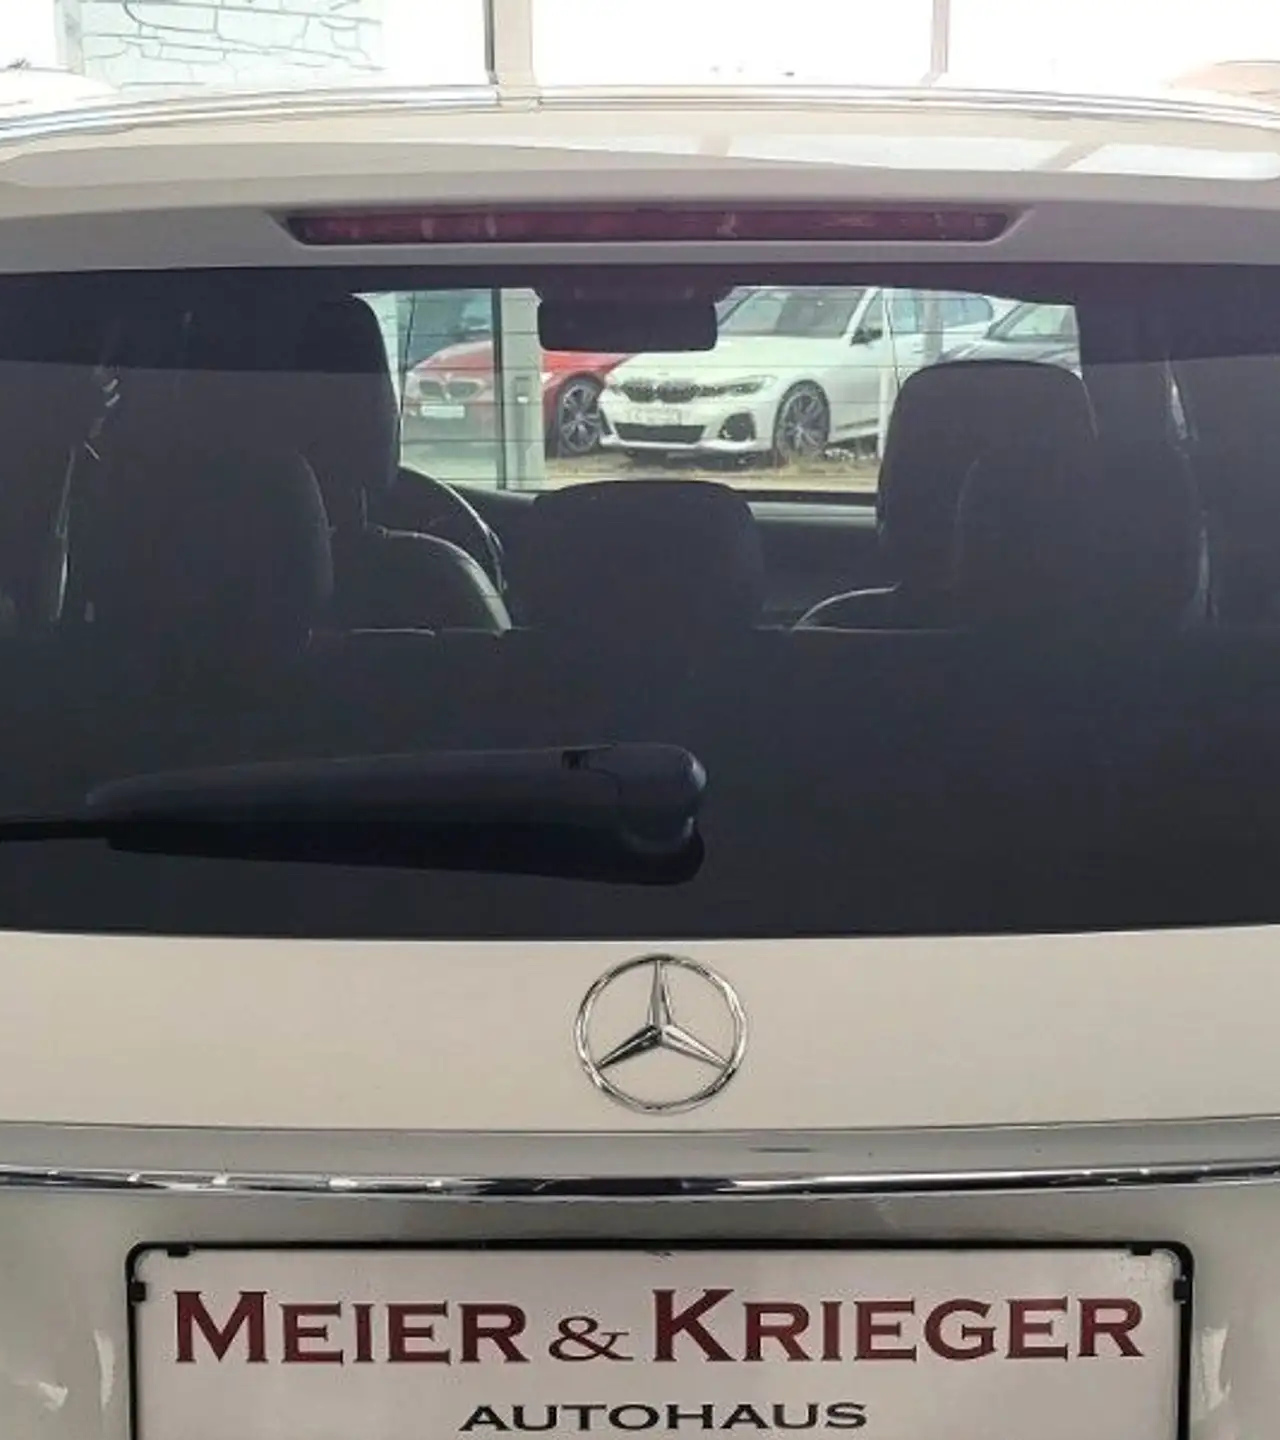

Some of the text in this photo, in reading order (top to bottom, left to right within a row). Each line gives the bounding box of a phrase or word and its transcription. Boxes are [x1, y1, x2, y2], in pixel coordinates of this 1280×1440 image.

[174, 1287, 1147, 1366] MEIER & KRIEGER
[458, 1402, 868, 1432] AUTOHAUS
